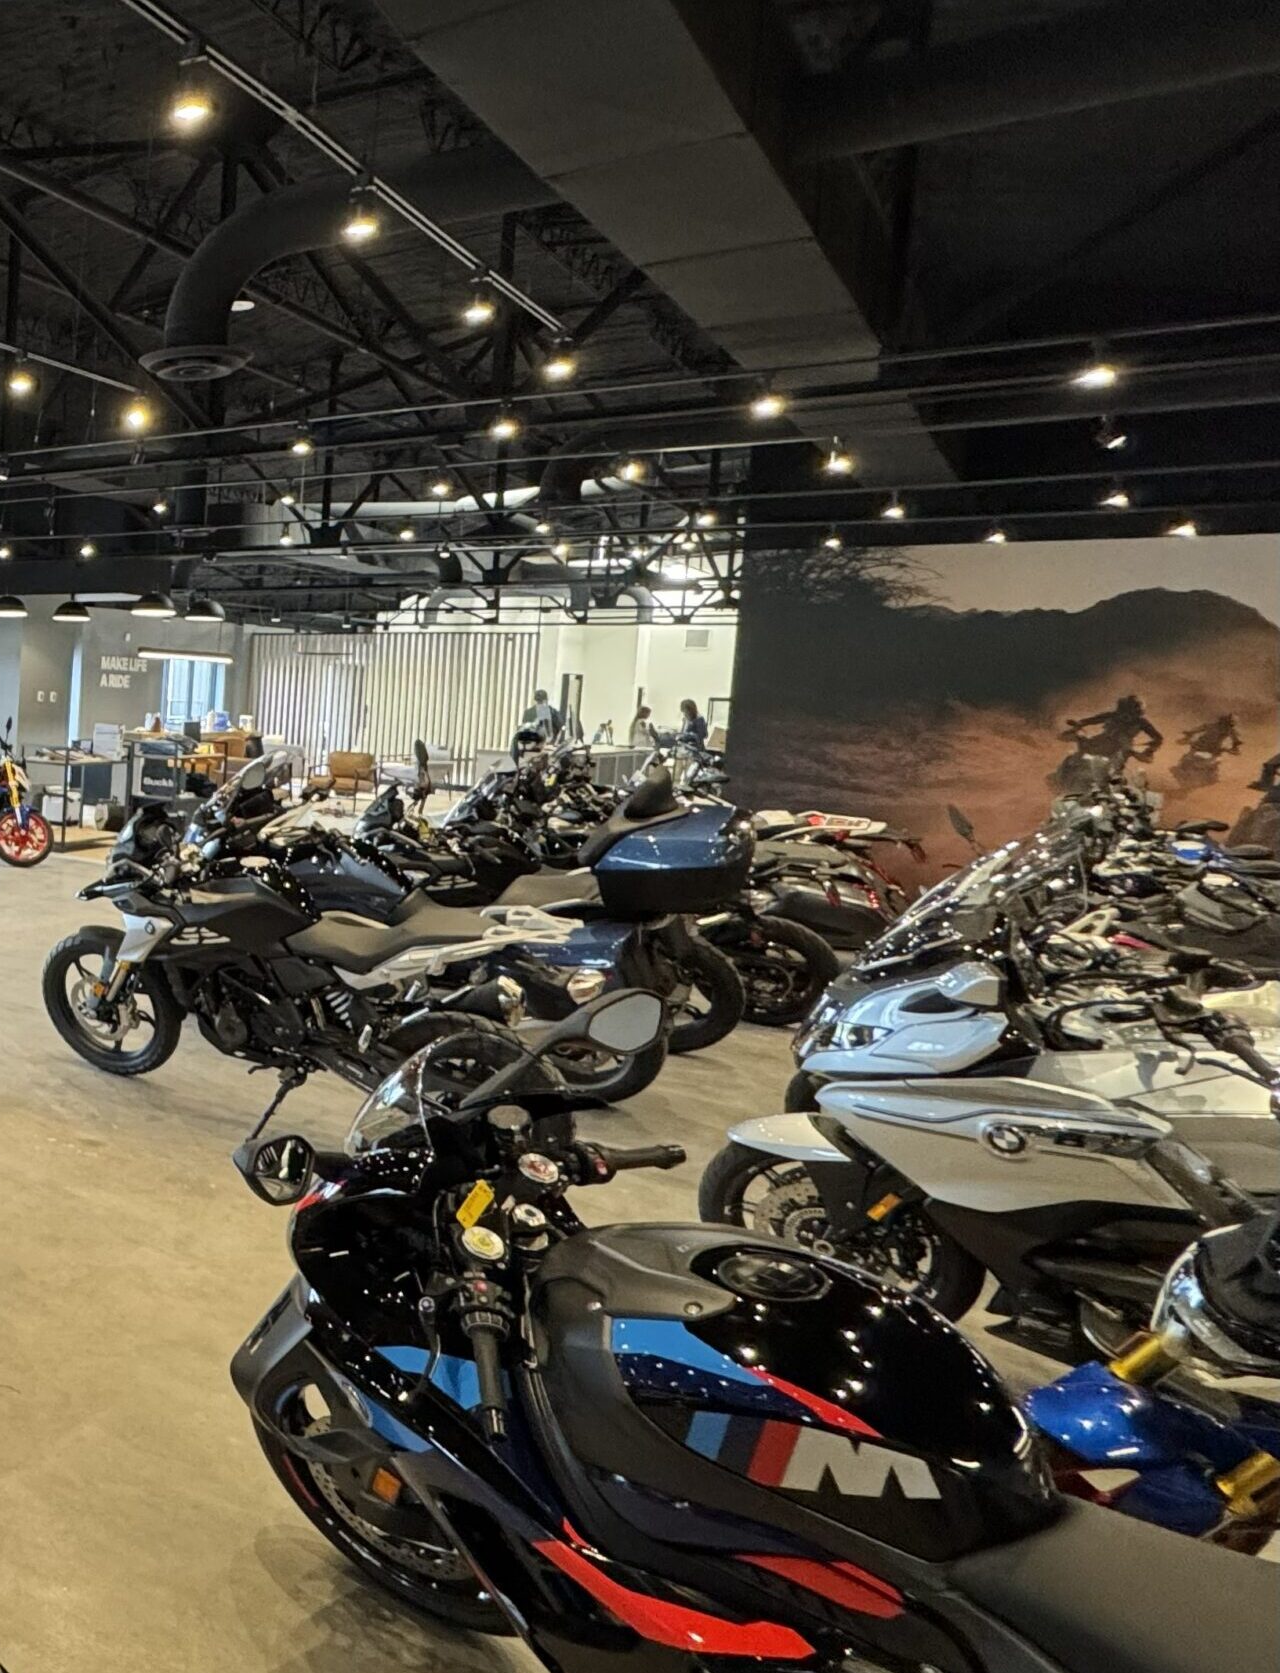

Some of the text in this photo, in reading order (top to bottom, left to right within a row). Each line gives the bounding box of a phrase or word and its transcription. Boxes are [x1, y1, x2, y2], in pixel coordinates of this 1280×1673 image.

[101, 656, 148, 672] MAKE LIFE
[100, 673, 130, 688] A RIDE
[778, 1425, 943, 1500] M
